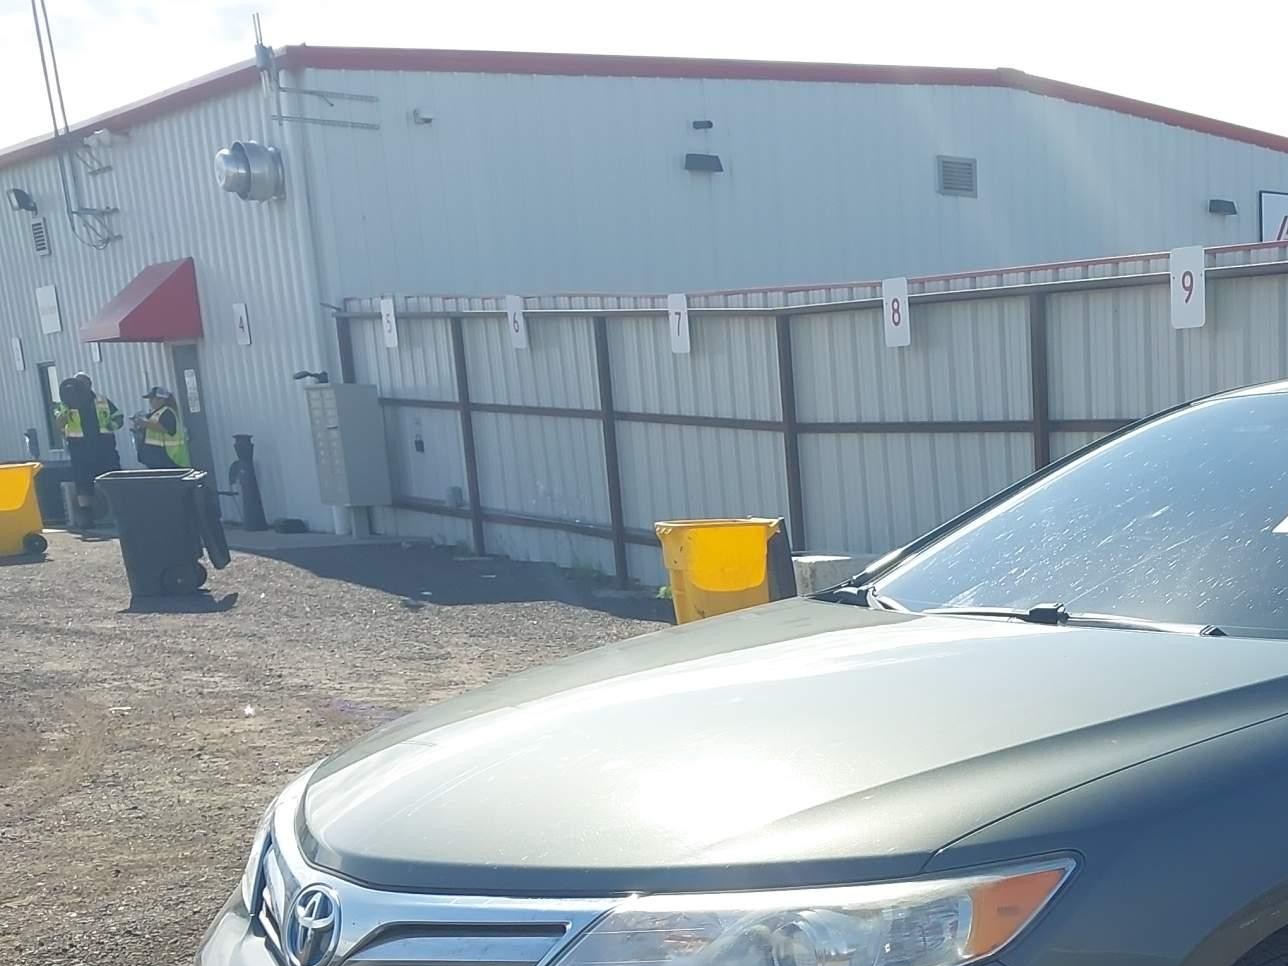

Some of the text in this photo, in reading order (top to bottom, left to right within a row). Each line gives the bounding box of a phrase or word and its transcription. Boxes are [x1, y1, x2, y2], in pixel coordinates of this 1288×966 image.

[1182, 270, 1194, 304] 9
[513, 312, 520, 333] 6
[675, 311, 681, 337] 7
[891, 298, 900, 327] 8
